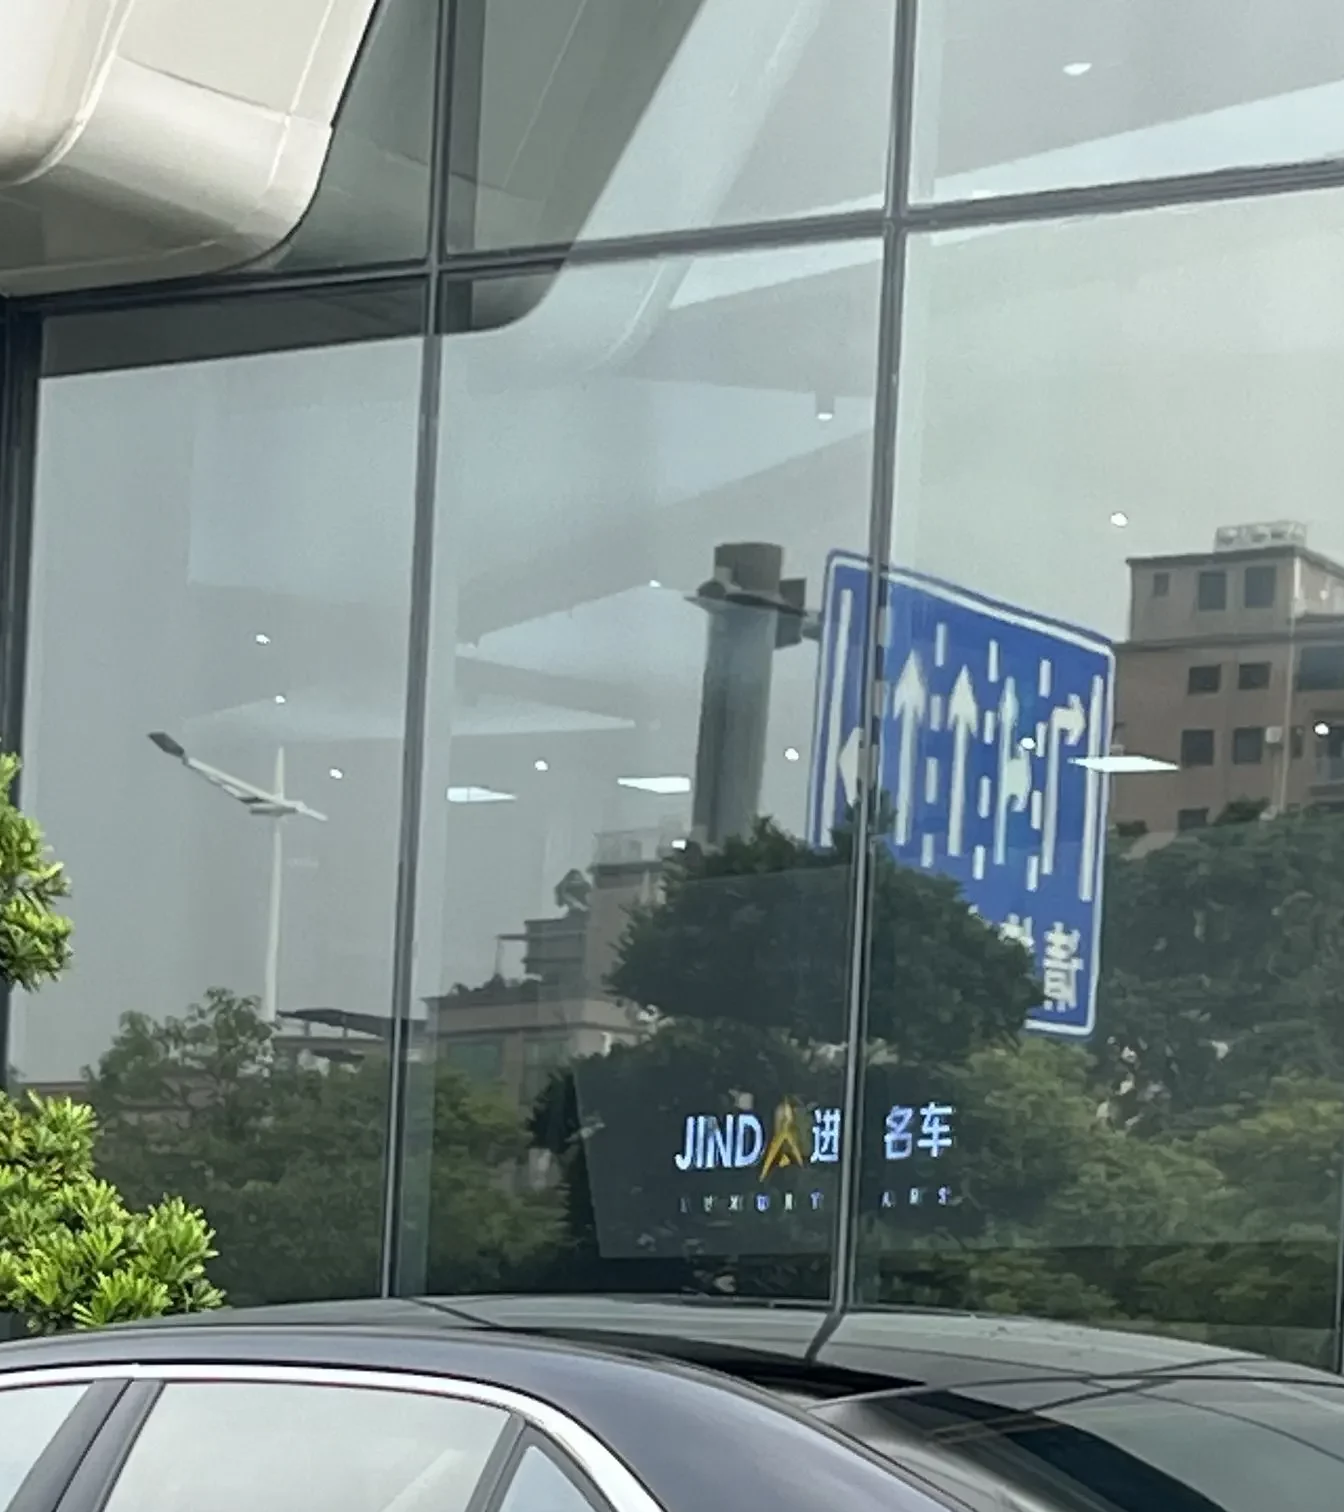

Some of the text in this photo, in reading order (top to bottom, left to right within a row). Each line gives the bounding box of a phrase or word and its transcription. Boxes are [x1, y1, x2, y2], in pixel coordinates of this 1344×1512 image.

[675, 1096, 954, 1183] JINDA 进名车
